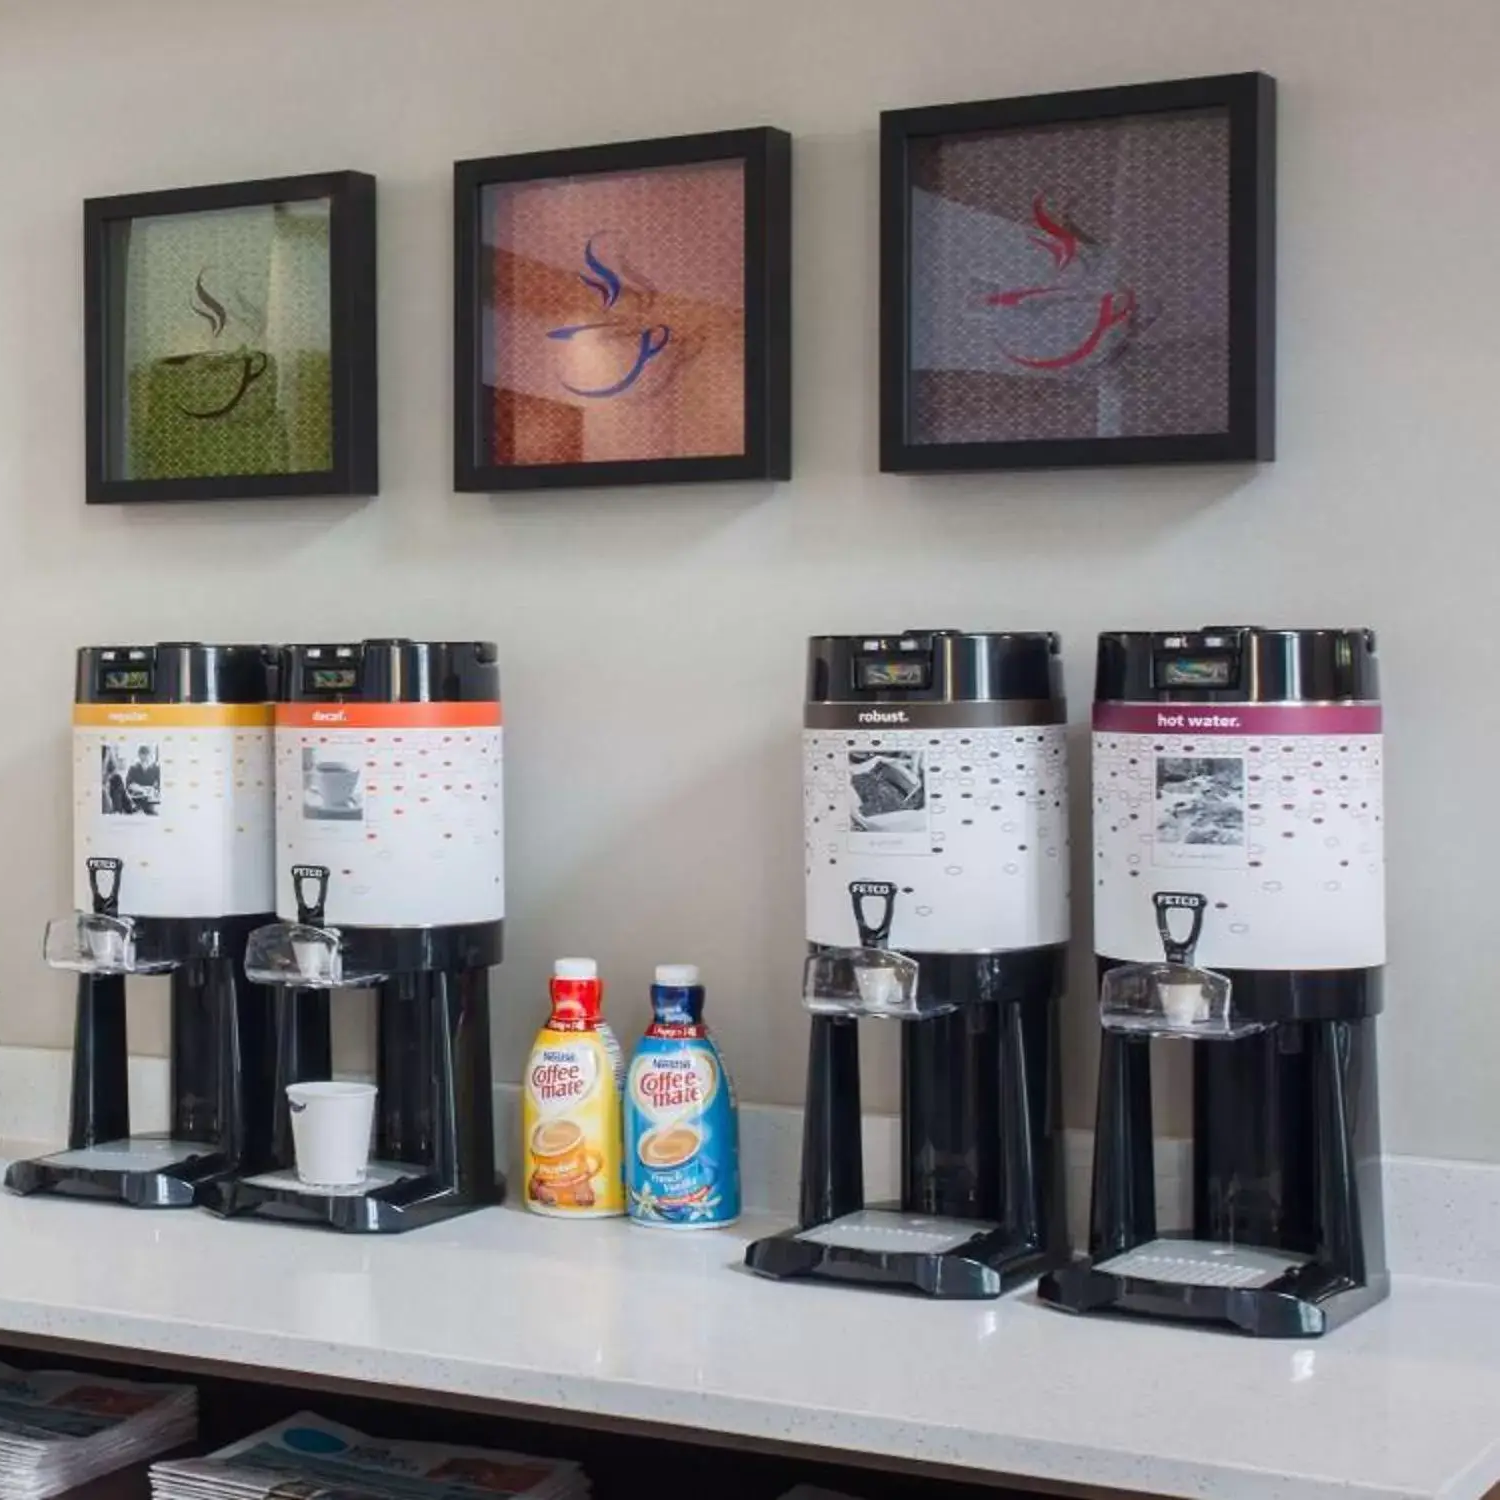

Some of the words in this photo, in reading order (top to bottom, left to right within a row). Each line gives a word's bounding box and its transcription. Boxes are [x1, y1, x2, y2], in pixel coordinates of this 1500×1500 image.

[858, 709, 910, 723] robust.
[1157, 712, 1184, 727] hot
[1187, 715, 1241, 728] water.
[852, 883, 890, 895] FETCO
[1157, 895, 1199, 907] FETCO
[532, 1064, 580, 1087] Coffee
[640, 1071, 697, 1096] Coffee
[541, 1079, 584, 1100] mate
[653, 1087, 700, 1108] mate
